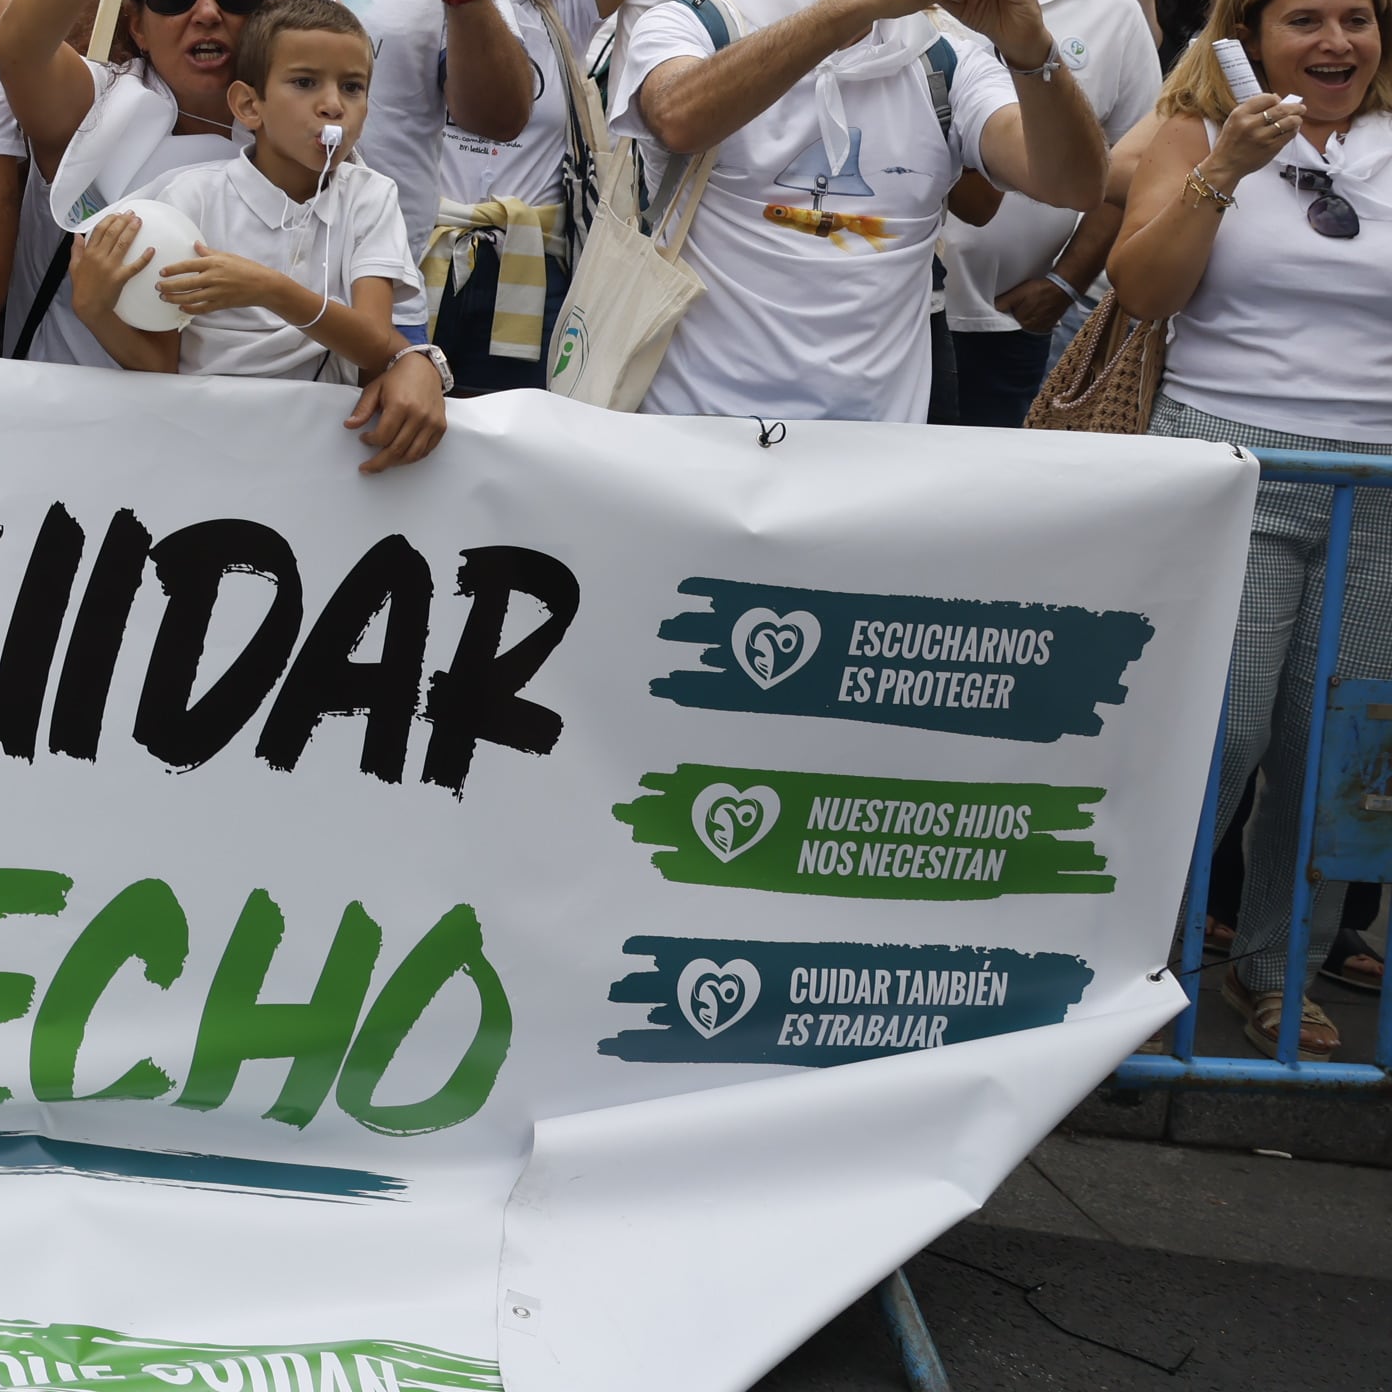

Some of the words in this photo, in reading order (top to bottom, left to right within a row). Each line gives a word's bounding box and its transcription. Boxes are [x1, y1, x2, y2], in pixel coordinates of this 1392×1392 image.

[848, 620, 1054, 665] ESCUCHARNOS
[837, 667, 872, 704] ES
[875, 668, 1016, 710] PROTEGER
[807, 796, 951, 837] NUESTROS
[953, 804, 1032, 840] HIJOS
[796, 840, 854, 876] NOS
[857, 844, 1006, 882] NECESITAN
[789, 965, 891, 1006] CUIDAR
[895, 962, 1008, 1007] TAMBIÉN
[778, 1013, 810, 1046] ES
[815, 1013, 949, 1048] TRABAJAR
